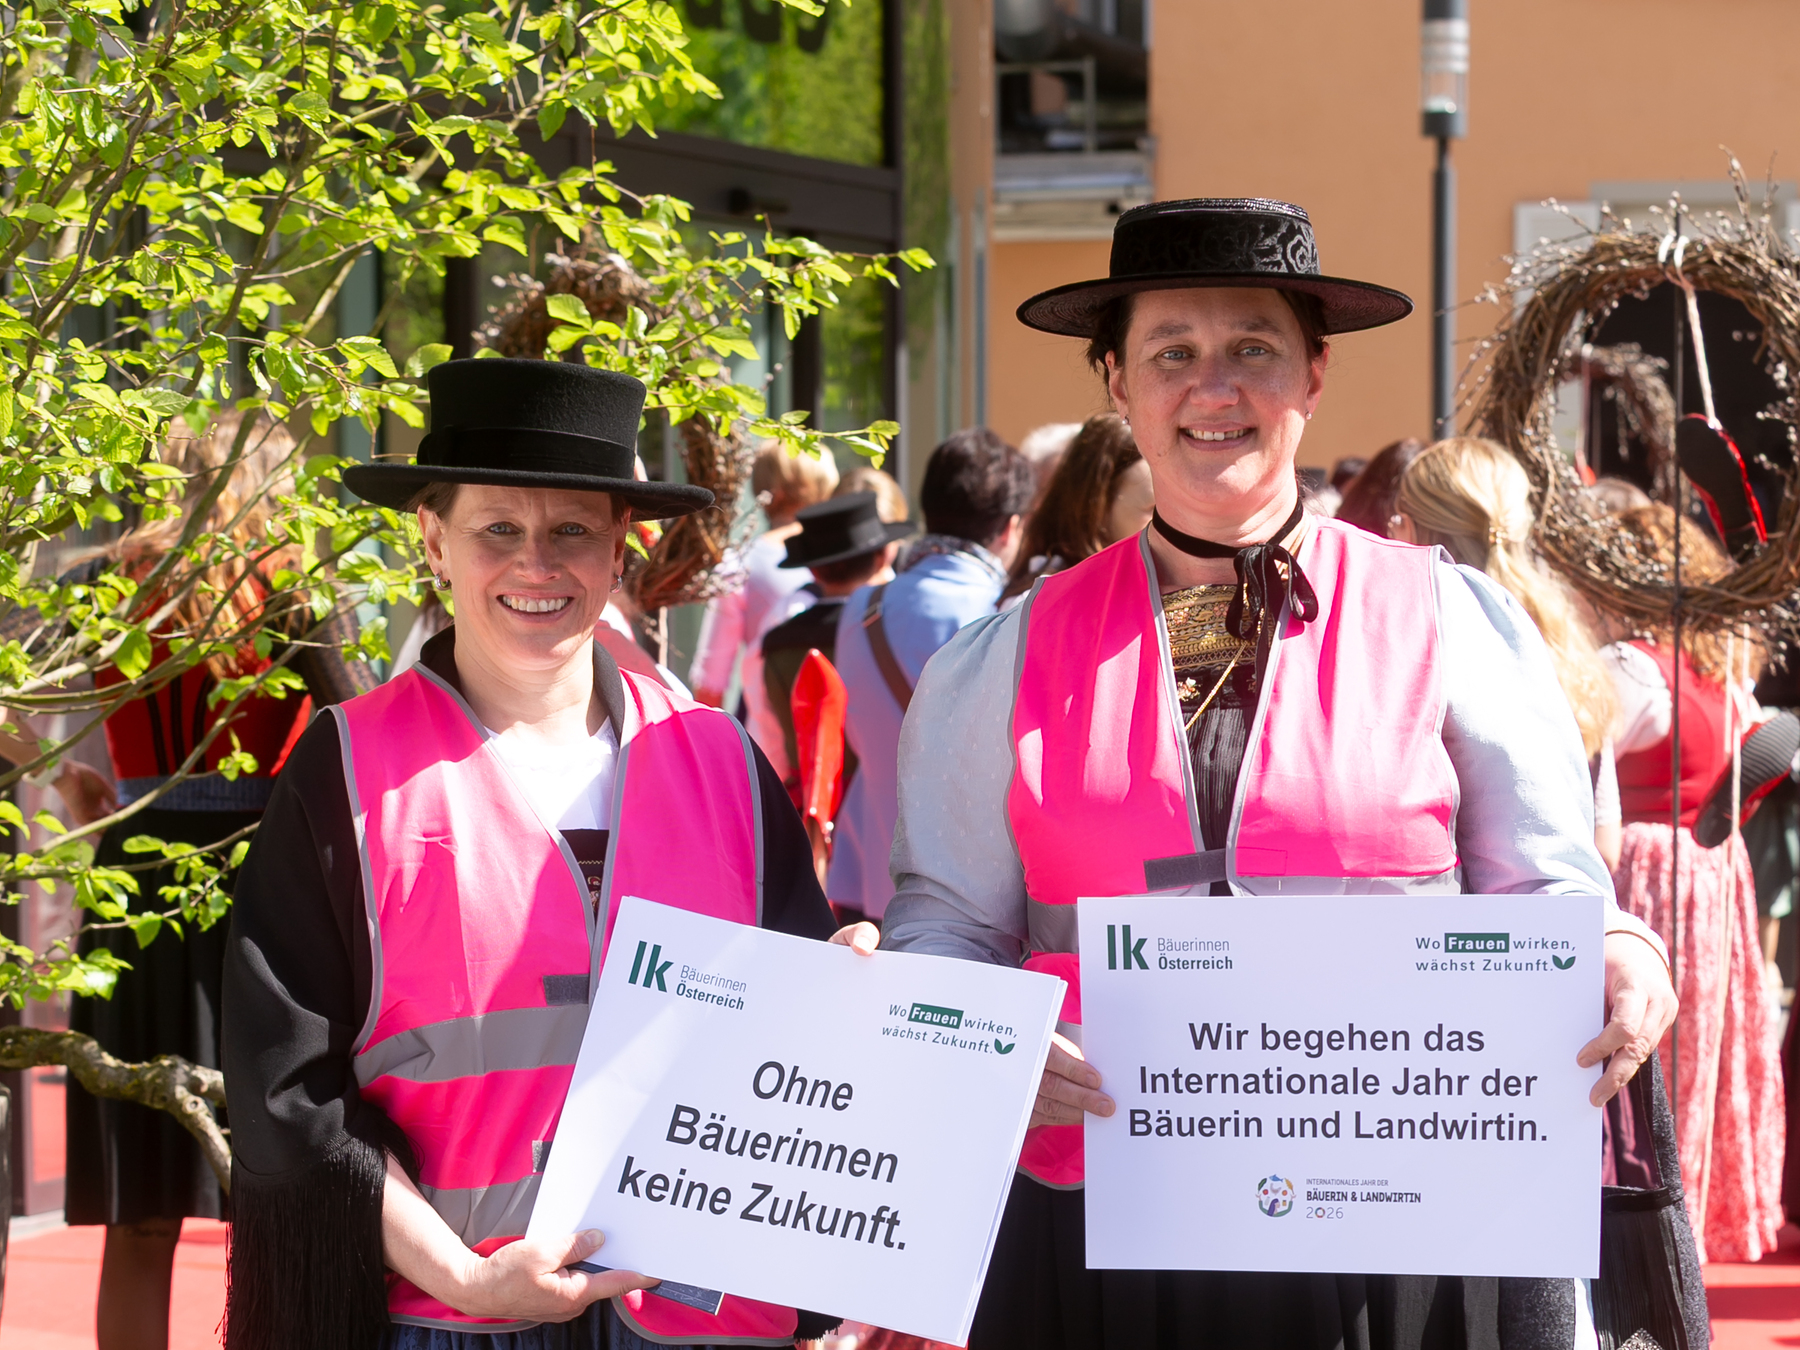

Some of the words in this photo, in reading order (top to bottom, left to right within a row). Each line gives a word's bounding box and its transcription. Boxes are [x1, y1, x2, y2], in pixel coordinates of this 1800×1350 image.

[1157, 937, 1230, 952] Bäuerinnen
[1415, 937, 1441, 950] Wo
[1448, 937, 1506, 950] Frauen
[1513, 937, 1576, 952] wirken,
[1158, 952, 1233, 970] Österreich
[1415, 959, 1476, 972] wächst
[1482, 959, 1554, 972] Zukunft.
[680, 964, 747, 993] Bäuerinnen
[676, 980, 745, 1011] Österreich
[889, 1004, 907, 1018] Wo
[911, 1006, 959, 1026] Frauen
[964, 1018, 1018, 1039] wirken,
[882, 1025, 928, 1042] wächst
[932, 1031, 993, 1054] Zukunft.
[1188, 1022, 1250, 1051] Wir
[1260, 1022, 1410, 1059] begehen
[1423, 1023, 1485, 1052] das
[752, 1060, 854, 1112] Ohne
[1139, 1065, 1381, 1096] Internationale
[1391, 1067, 1470, 1096] Jahr
[1481, 1067, 1538, 1097] der
[1129, 1108, 1263, 1138] Bäuerin
[1276, 1110, 1341, 1139] und
[1354, 1110, 1548, 1142] Landwirtin.
[665, 1103, 898, 1184] Bäuerinnen
[1306, 1178, 1359, 1186] INTERNATIONALES
[1360, 1179, 1376, 1187] JAHR
[1377, 1179, 1389, 1187] DER
[1306, 1188, 1348, 1202] BÄUERIN
[1350, 1191, 1358, 1202] &
[1360, 1192, 1421, 1203] LANDWIRTIN
[617, 1155, 732, 1216] keine
[739, 1182, 907, 1251] Zukunft.
[1306, 1206, 1344, 1219] 2026
